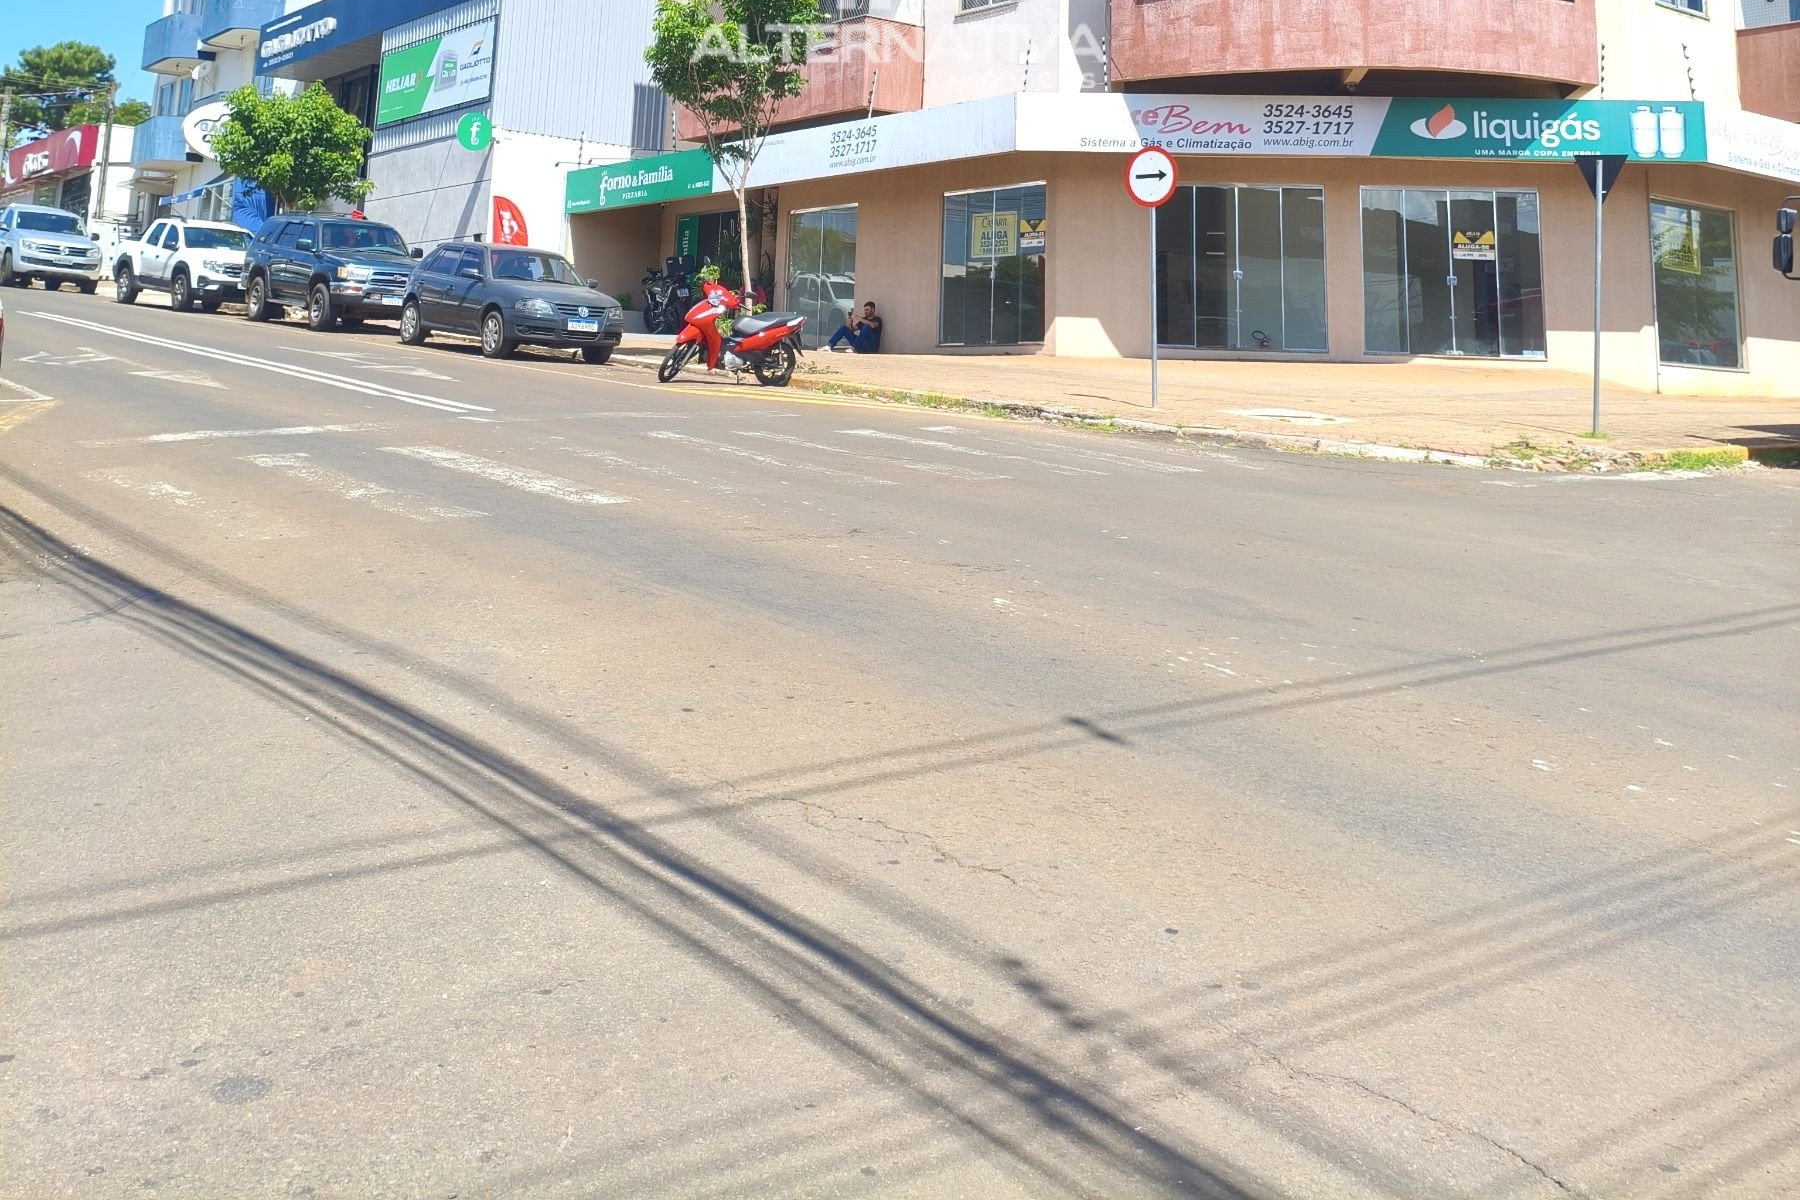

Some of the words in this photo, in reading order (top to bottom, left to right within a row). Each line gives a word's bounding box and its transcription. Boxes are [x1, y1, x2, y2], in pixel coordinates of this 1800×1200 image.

[459, 57, 491, 71] GAGLIOTTO
[385, 72, 417, 94] HELIAR
[1262, 103, 1353, 119] 3524-3645
[829, 124, 878, 145] 3524-3645
[1262, 120, 1354, 135] 3527-1717
[1473, 110, 1601, 148] liquigás
[829, 139, 878, 159] 3527-1717
[1080, 137, 1126, 147] Sistema
[1140, 137, 1162, 148] Gás
[1166, 140, 1173, 149] e
[1176, 137, 1252, 150] Climatização
[1263, 136, 1354, 149] www.abig.com.br
[1533, 149, 1559, 157] COPA
[638, 165, 674, 186] Família
[622, 190, 648, 200] PIZZARIA
